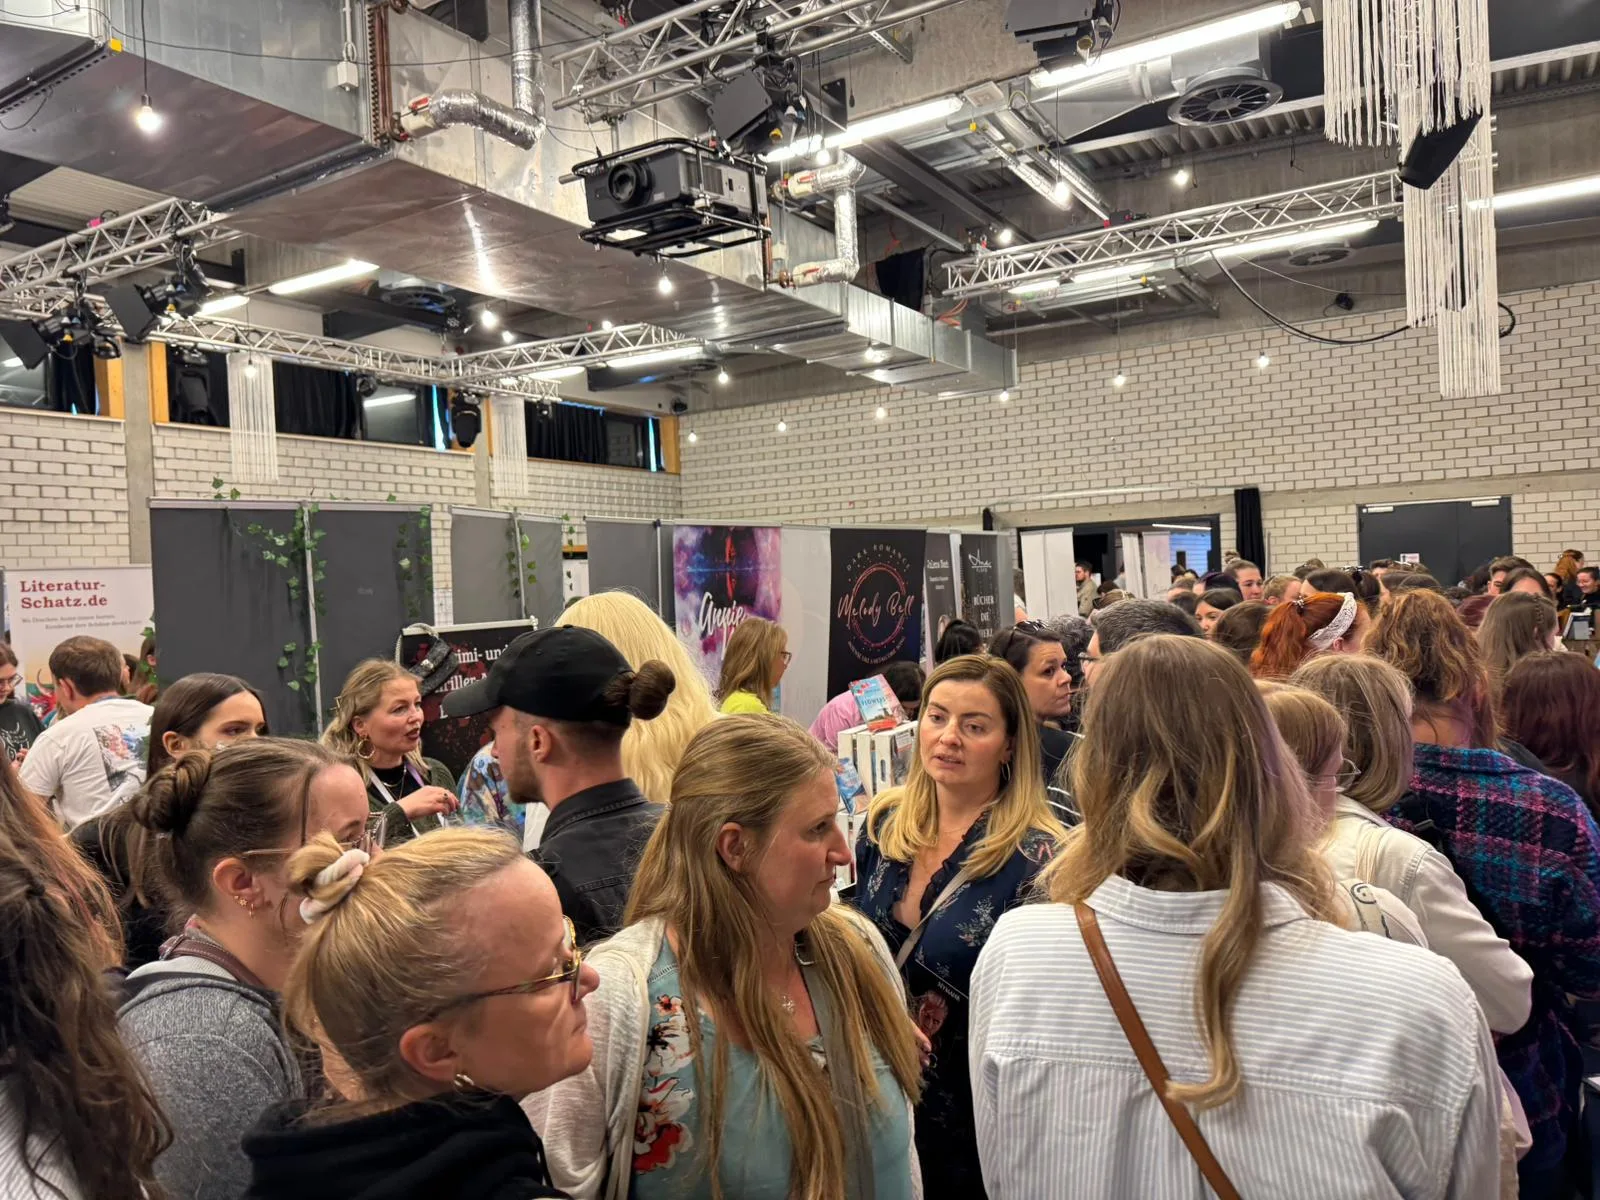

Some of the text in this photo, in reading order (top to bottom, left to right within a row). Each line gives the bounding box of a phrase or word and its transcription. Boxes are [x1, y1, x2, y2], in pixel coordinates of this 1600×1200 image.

[20, 580, 107, 593] Literatur-
[21, 595, 108, 609] Schatz.de
[837, 591, 915, 630] Melody Bell
[455, 647, 483, 664] imi-
